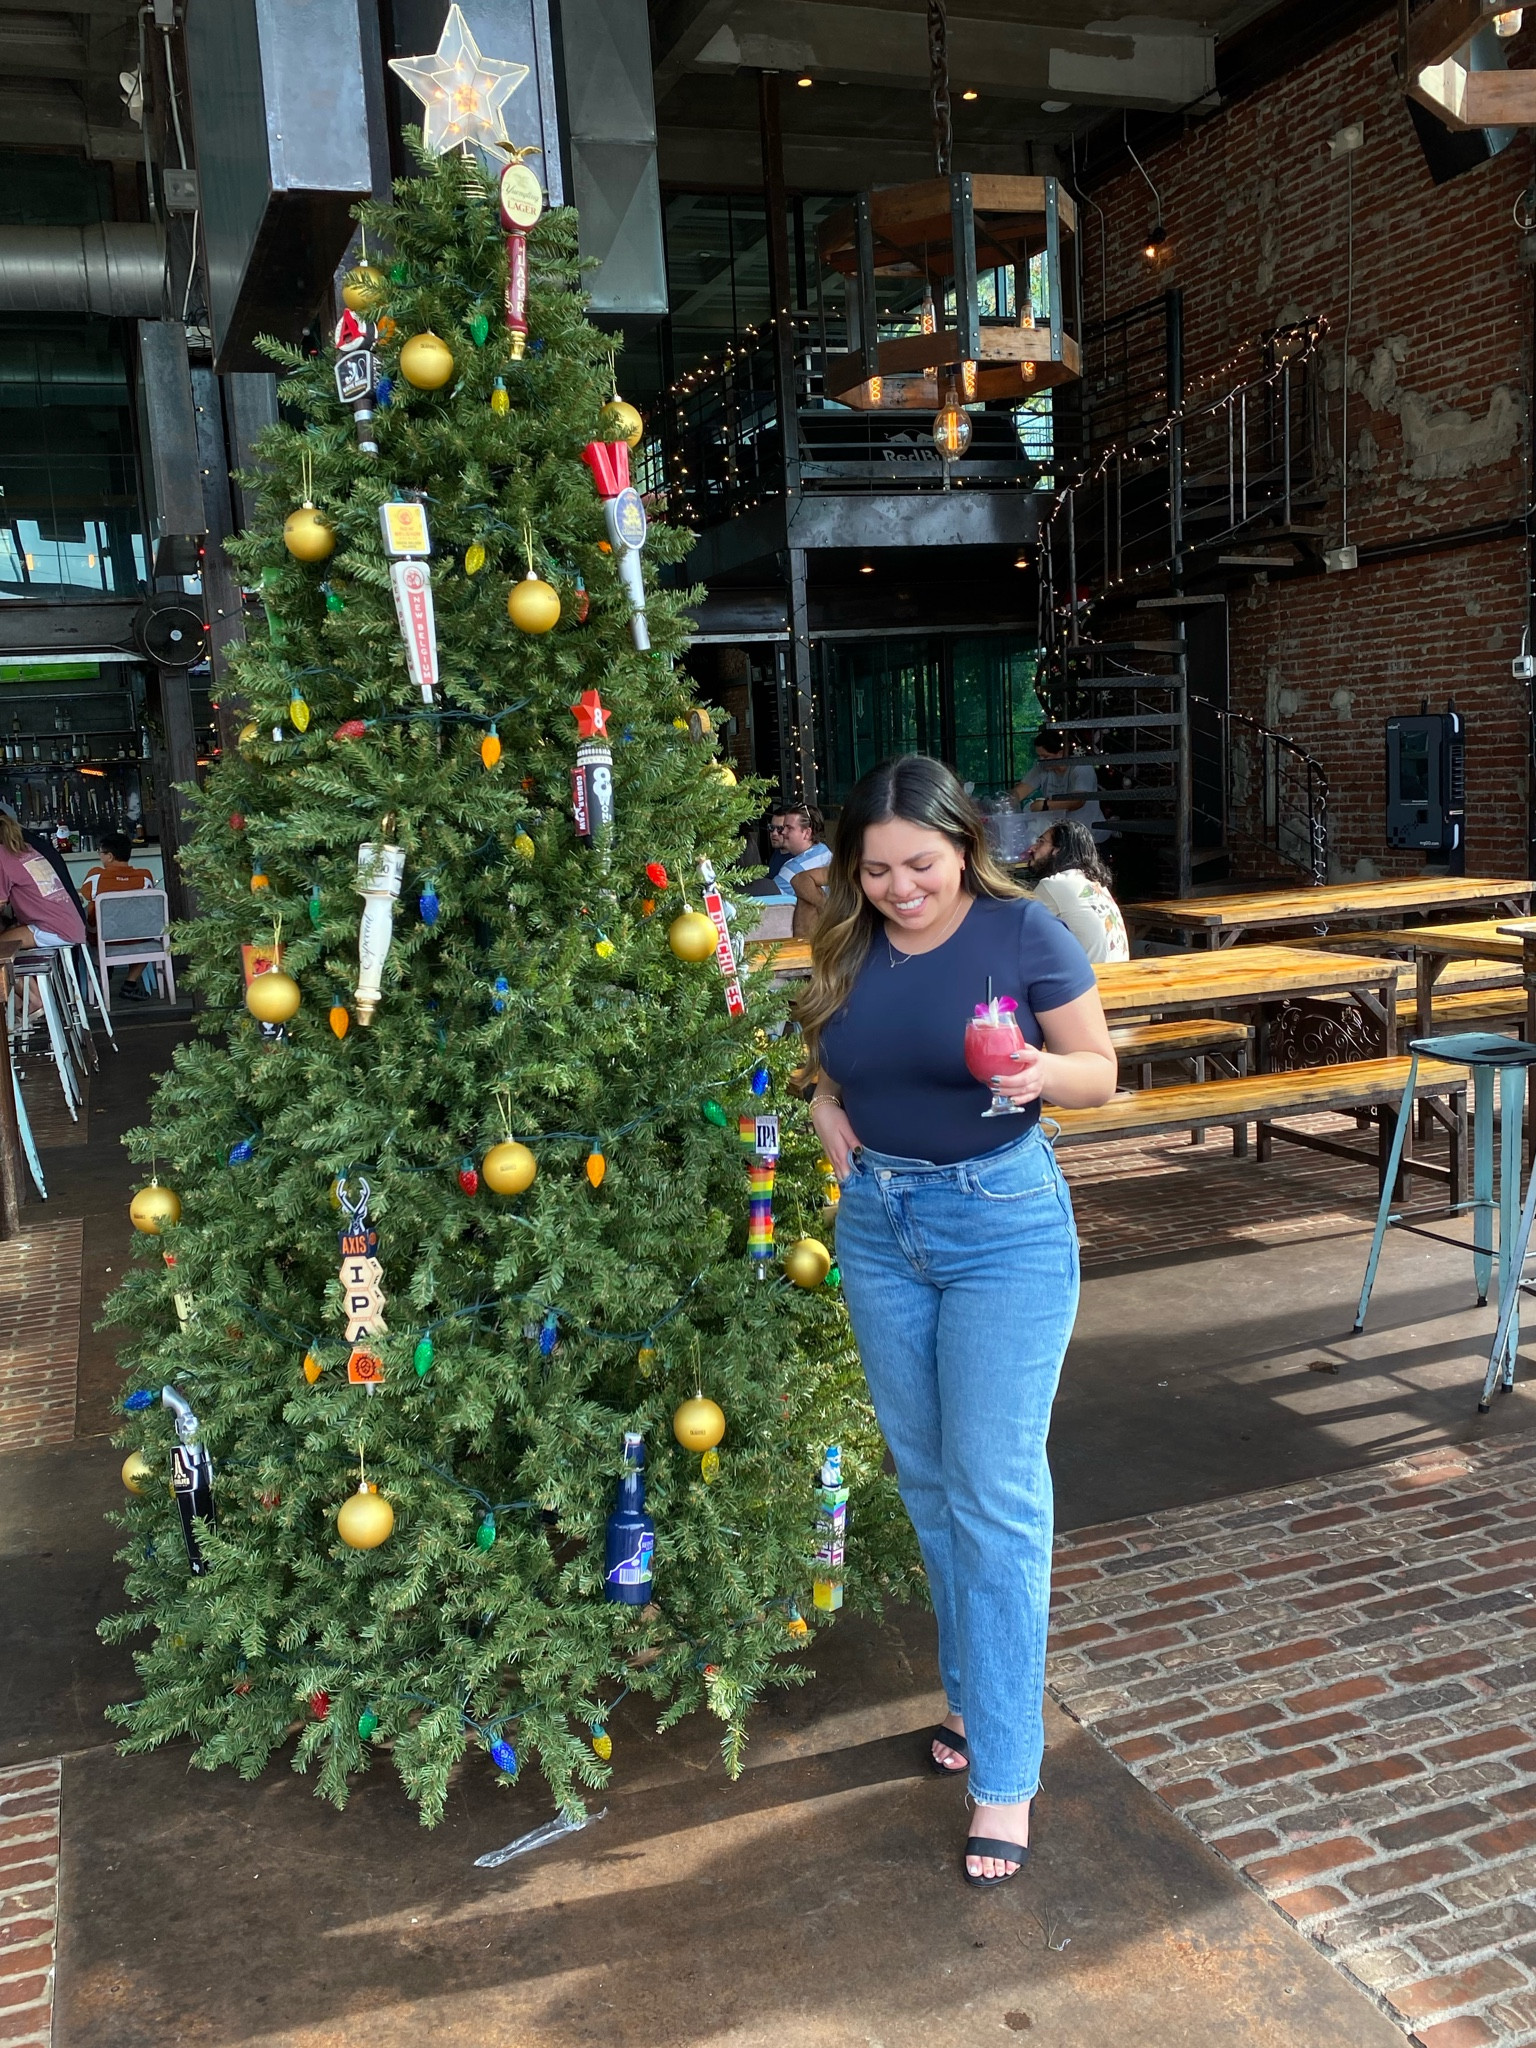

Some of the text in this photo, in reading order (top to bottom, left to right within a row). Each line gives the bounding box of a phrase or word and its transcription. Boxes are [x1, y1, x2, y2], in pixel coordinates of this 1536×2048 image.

[507, 200, 537, 216] LAGER
[516, 254, 526, 314] LAGER
[882, 449, 920, 461] Red
[413, 596, 431, 678] NEW BELGIUM
[594, 707, 603, 729] 8
[576, 776, 586, 830] COUGAR PAW
[711, 911, 741, 1006] DESCHUES
[757, 1125, 777, 1148] IPA
[342, 1235, 367, 1255] AXIS
[350, 1266, 370, 1342] IPA
